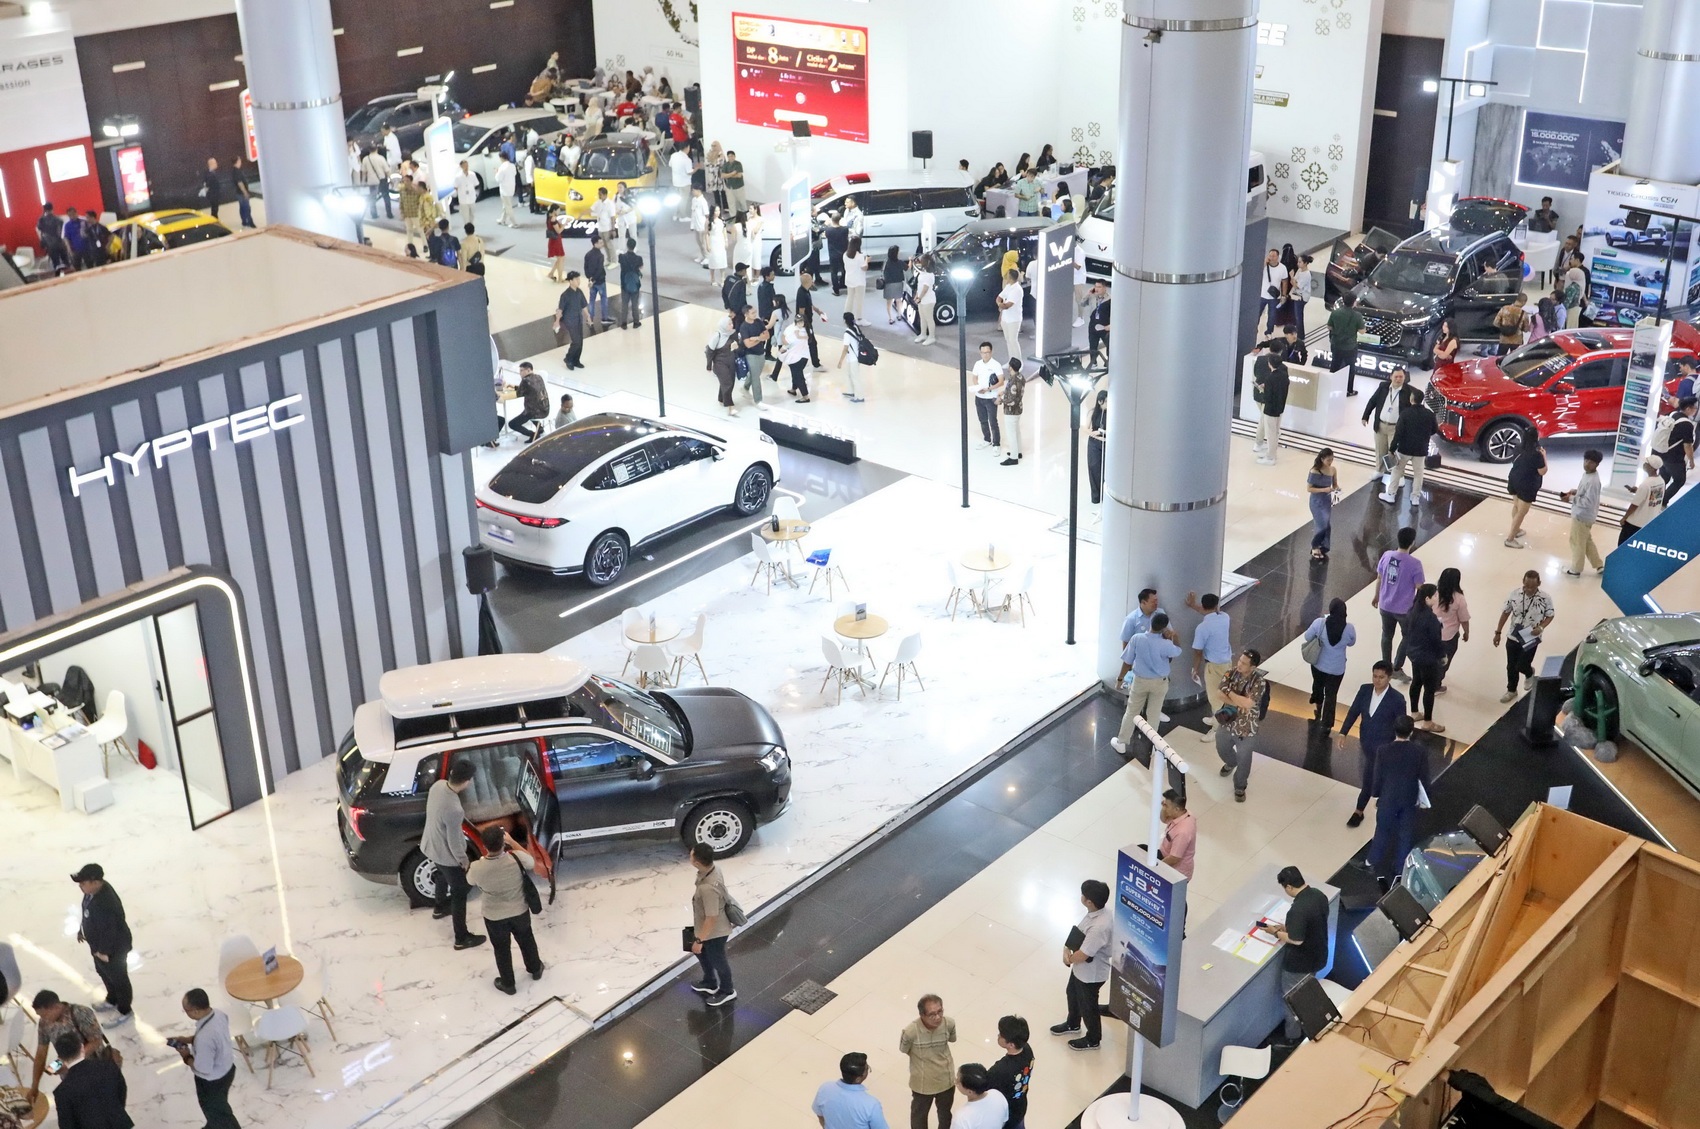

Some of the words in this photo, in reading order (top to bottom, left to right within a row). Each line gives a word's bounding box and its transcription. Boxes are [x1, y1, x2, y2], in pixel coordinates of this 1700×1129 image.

[0, 55, 63, 73] RAGES
[768, 46, 778, 64] 8
[828, 54, 838, 72] 2
[556, 214, 599, 235] Bing
[1360, 354, 1377, 370] 8
[69, 394, 305, 497] HYPTEC
[1627, 540, 1688, 561] JAECOO
[1129, 864, 1161, 887] JAECOO
[1125, 885, 1141, 899] SUPER
